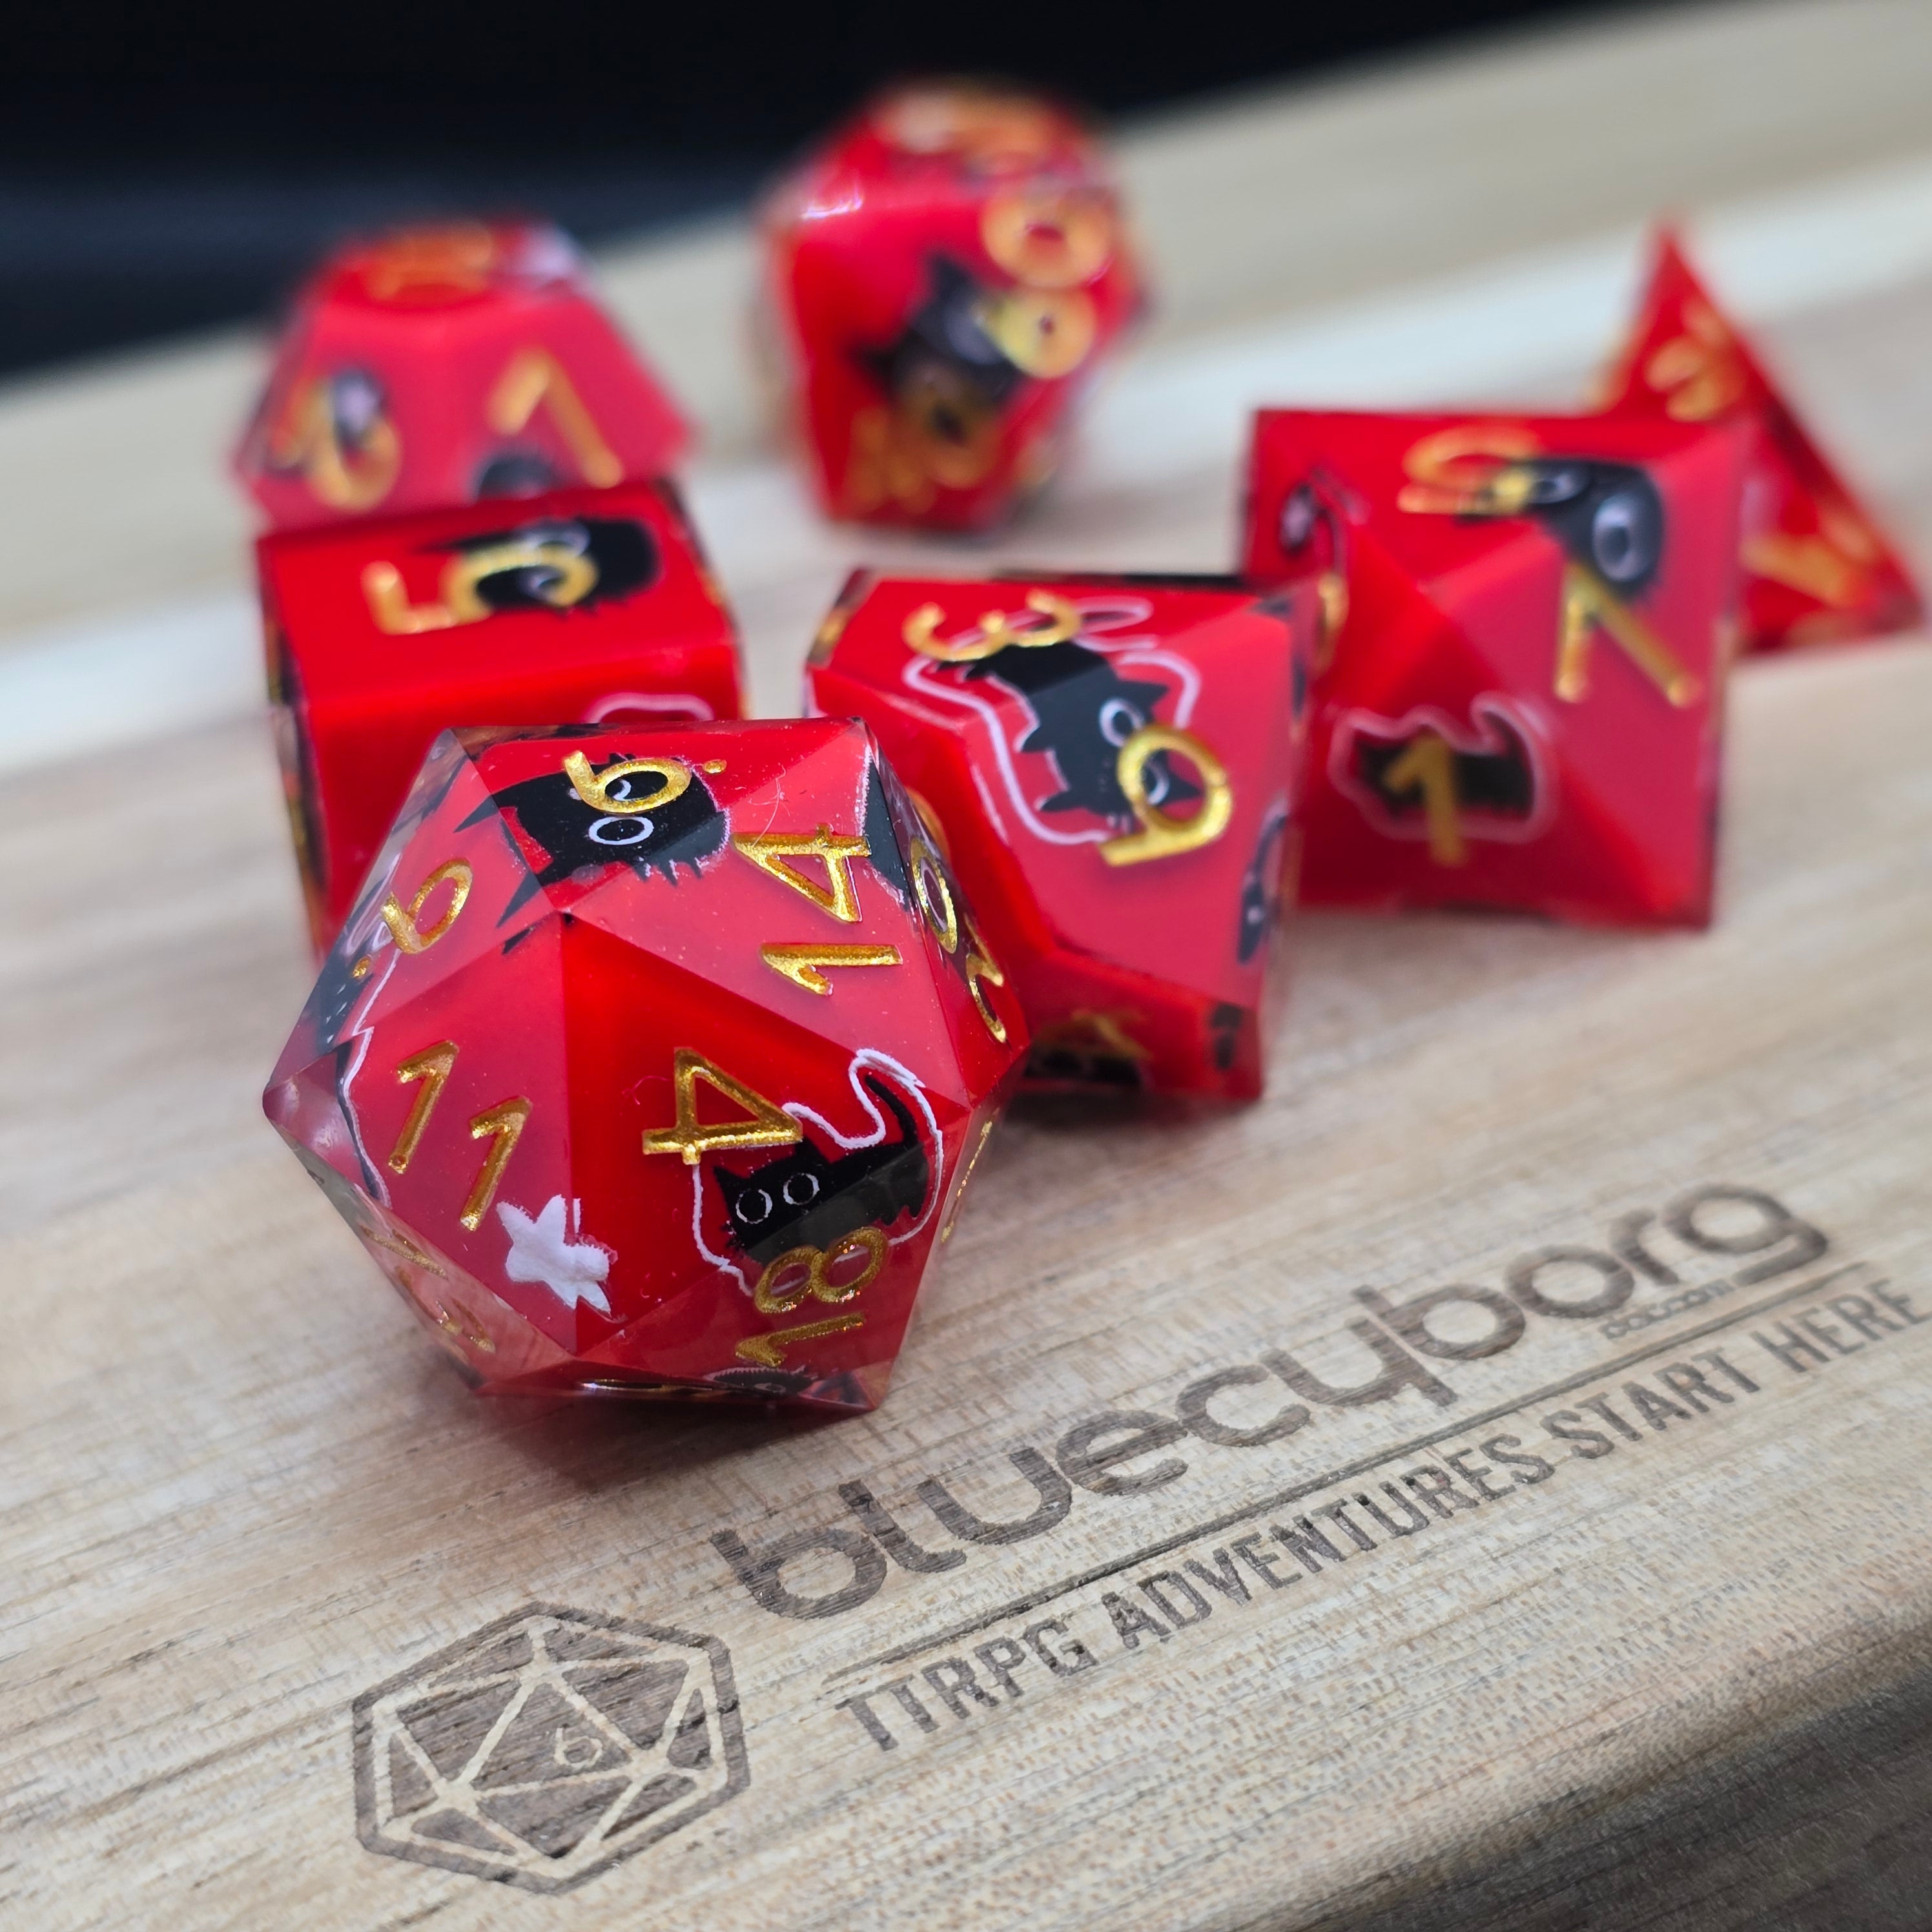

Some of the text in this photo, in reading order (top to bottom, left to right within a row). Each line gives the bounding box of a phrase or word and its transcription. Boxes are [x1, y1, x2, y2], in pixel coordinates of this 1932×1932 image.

[730, 823, 903, 996] 14
[642, 1046, 803, 1166] 4
[708, 1183, 1829, 1619] bluecyborg
[836, 1278, 1932, 1751] TTRPG ADVENTURES START HERE
